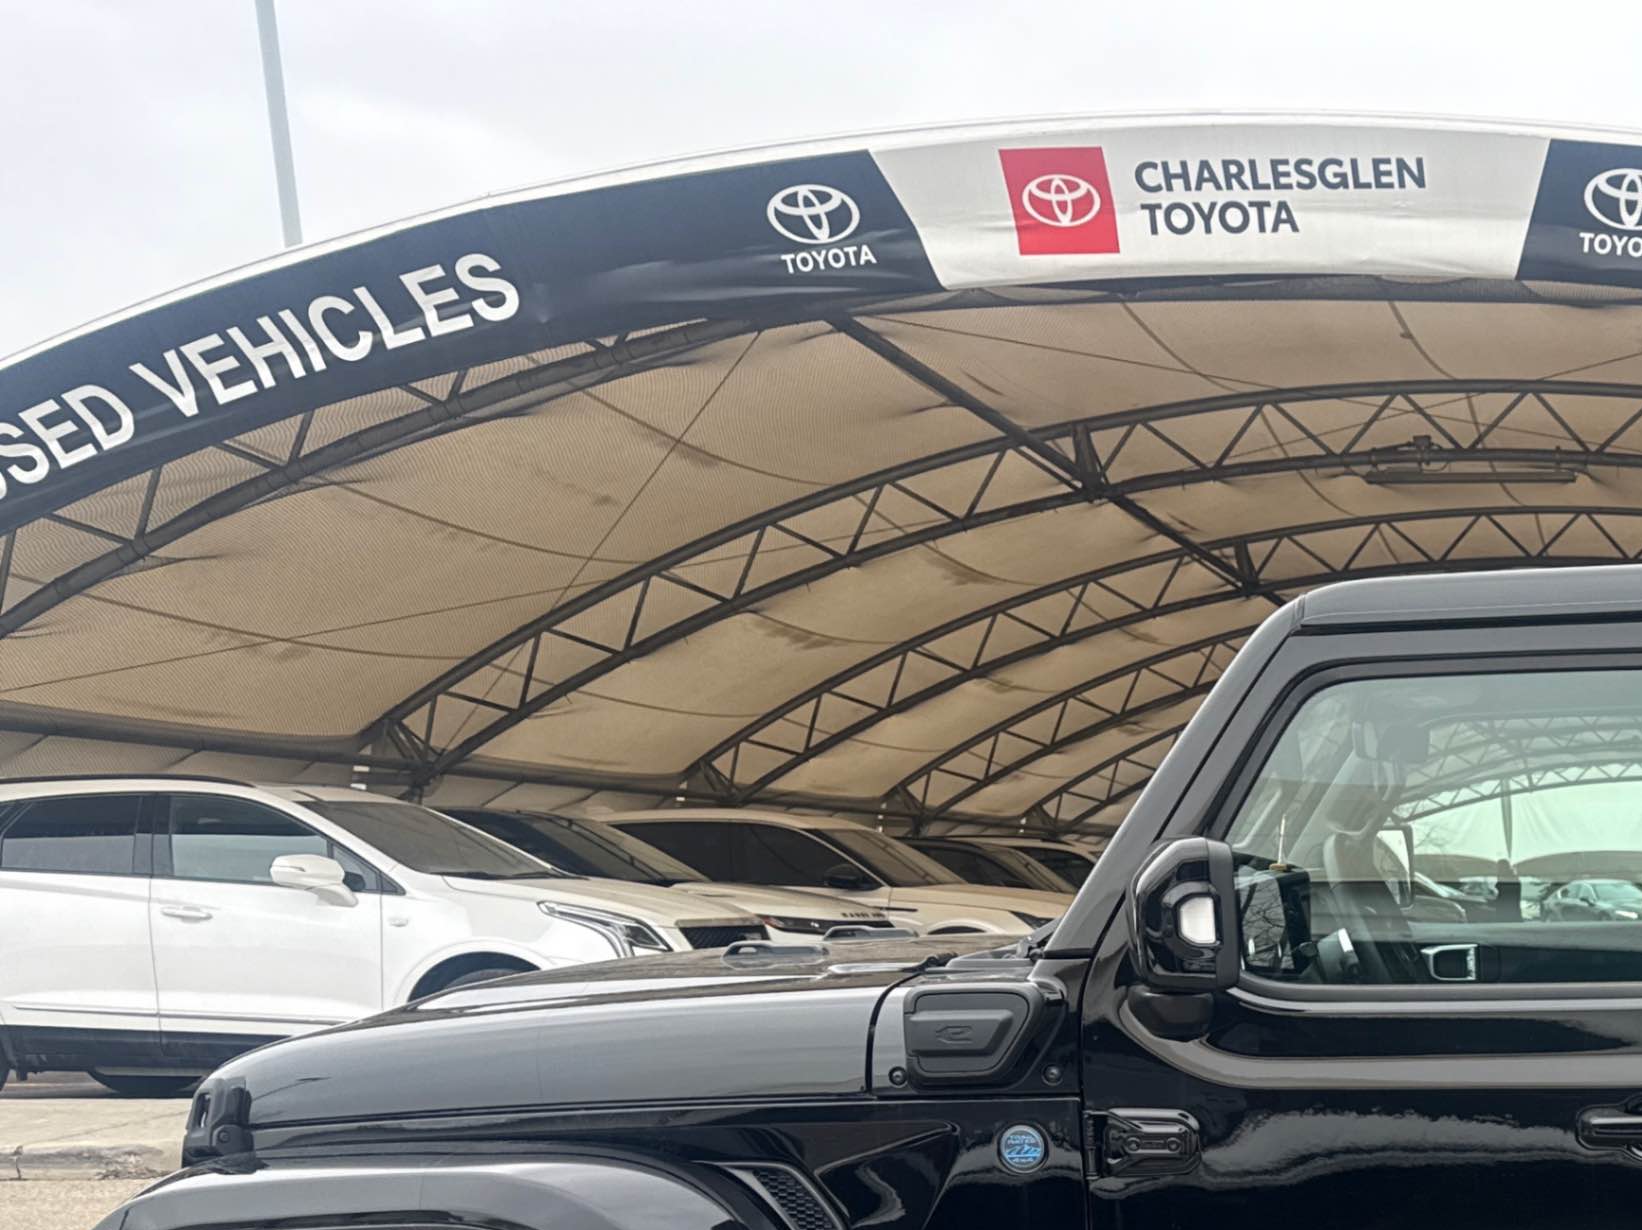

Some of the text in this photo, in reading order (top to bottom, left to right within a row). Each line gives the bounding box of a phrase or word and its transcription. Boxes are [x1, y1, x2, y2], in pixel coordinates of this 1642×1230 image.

[1133, 156, 1427, 193] CHARLESGLEN
[1140, 199, 1300, 236] TOYOTA
[780, 244, 877, 274] TOYOTA
[128, 252, 520, 417] VEHICLES
